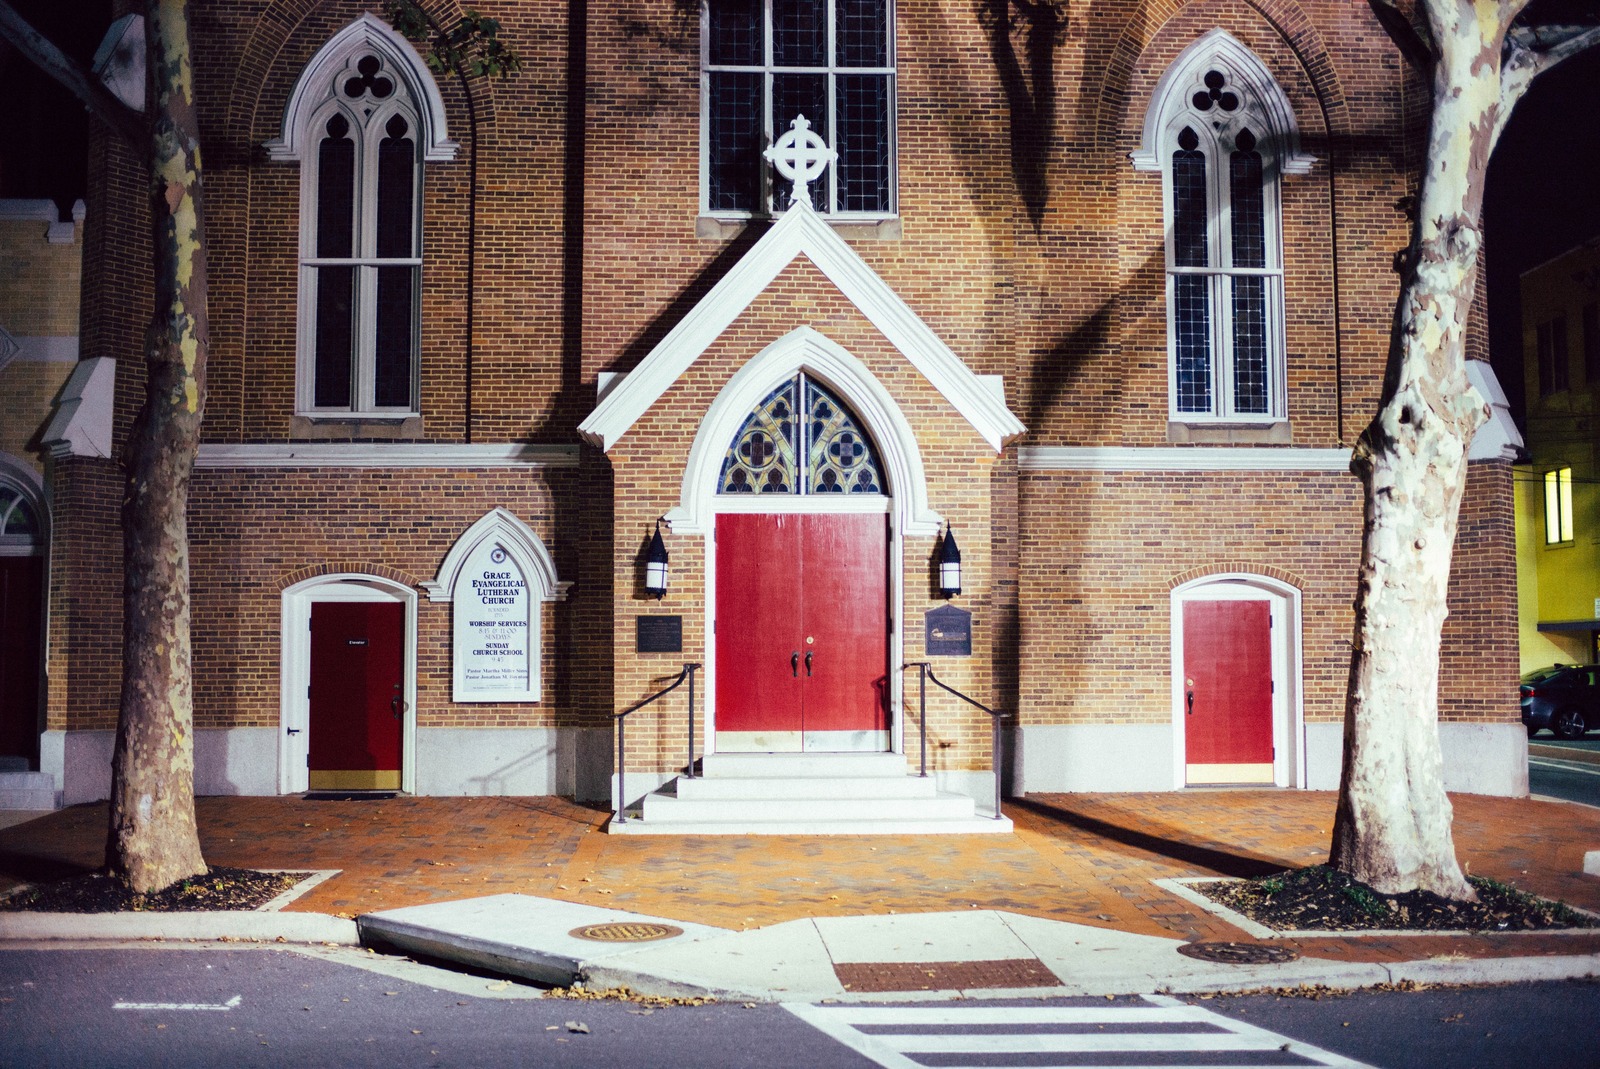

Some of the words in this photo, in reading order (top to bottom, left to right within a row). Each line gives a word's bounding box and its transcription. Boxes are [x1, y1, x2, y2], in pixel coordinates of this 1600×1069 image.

[483, 571, 511, 579] GRACE
[472, 580, 526, 588] EVANGELICAL
[477, 588, 519, 596] LUTHERAN
[482, 596, 514, 604] CHURCH
